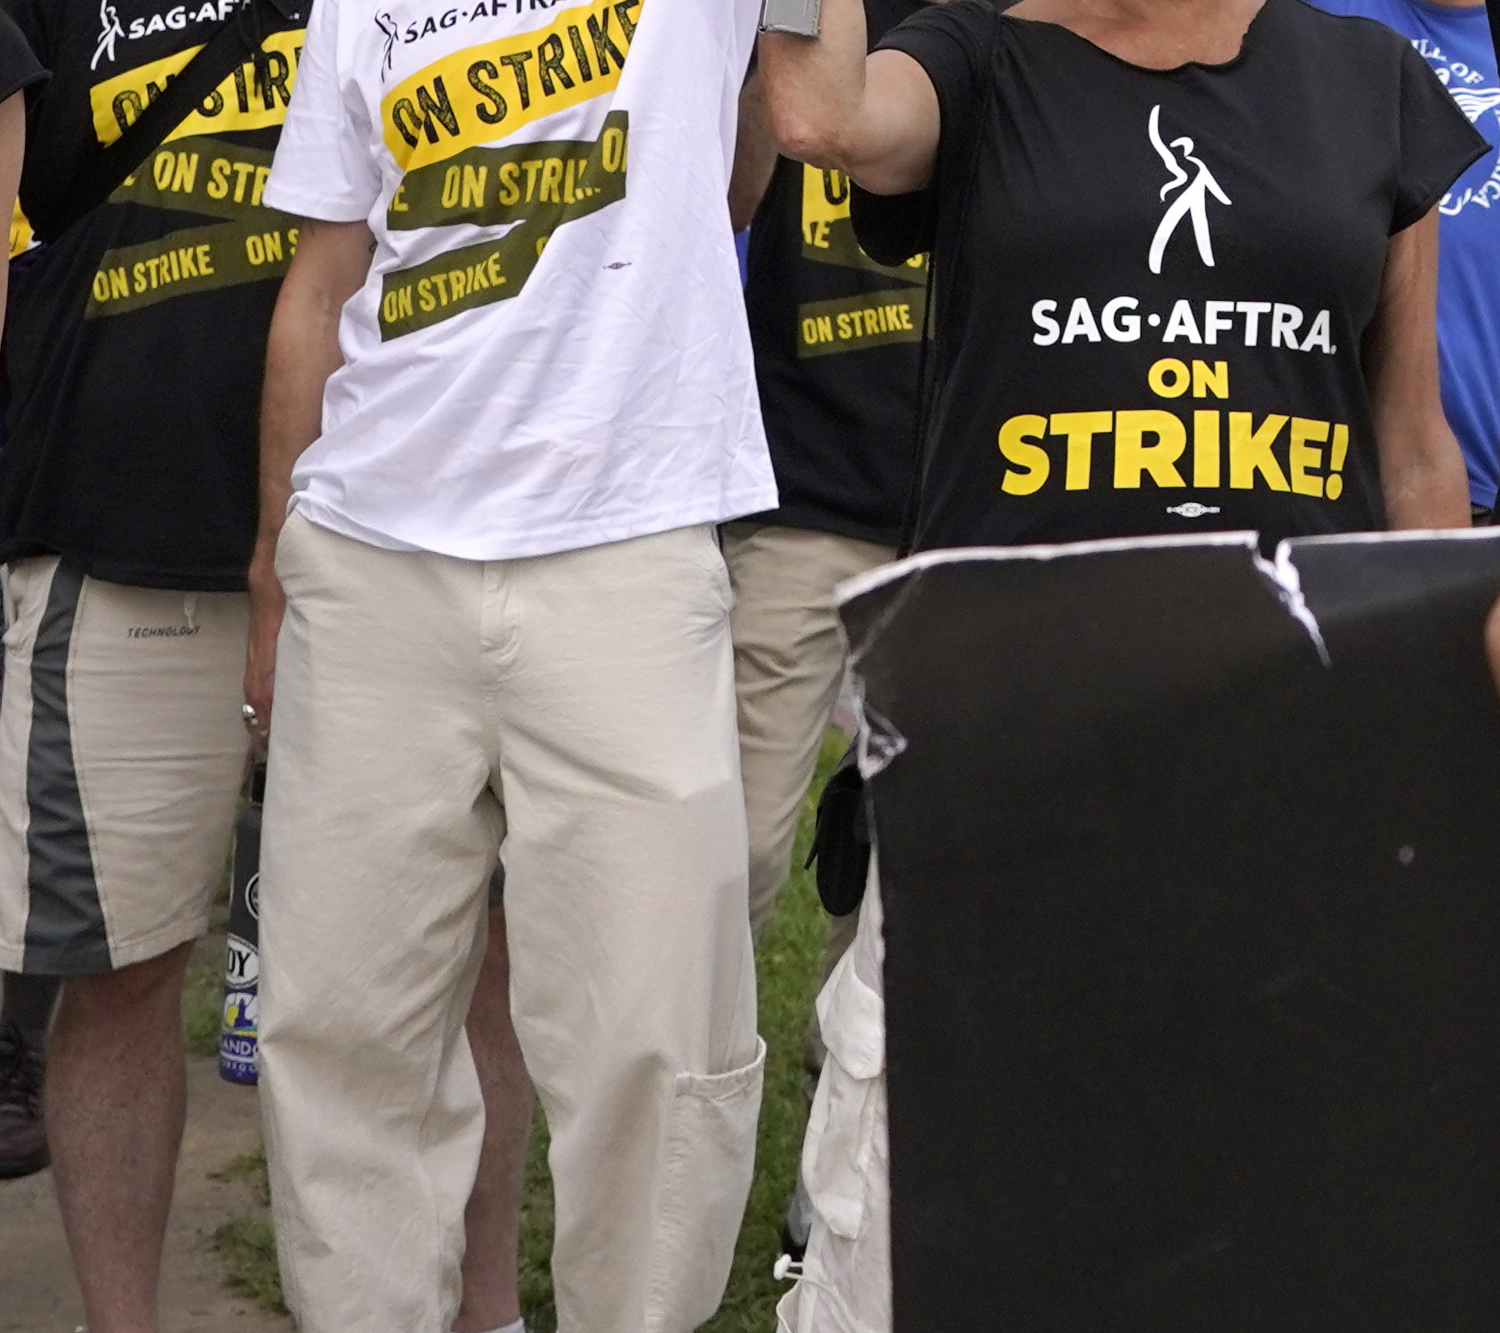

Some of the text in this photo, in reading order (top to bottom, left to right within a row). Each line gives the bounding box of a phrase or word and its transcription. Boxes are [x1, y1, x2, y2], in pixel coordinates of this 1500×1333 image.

[1450, 62, 1486, 85] OF
[392, 74, 461, 149] ON
[153, 150, 200, 194] ON
[441, 164, 488, 210] ON
[93, 267, 130, 303] ON
[134, 243, 216, 294] STRIKE
[245, 231, 284, 266] ON
[383, 251, 508, 324] ON STRIKE
[802, 303, 915, 346] ON STRIKE
[1030, 295, 1332, 355] SAG·AFTRA
[1148, 357, 1230, 400] ON
[998, 409, 1350, 502] STRIKE!
